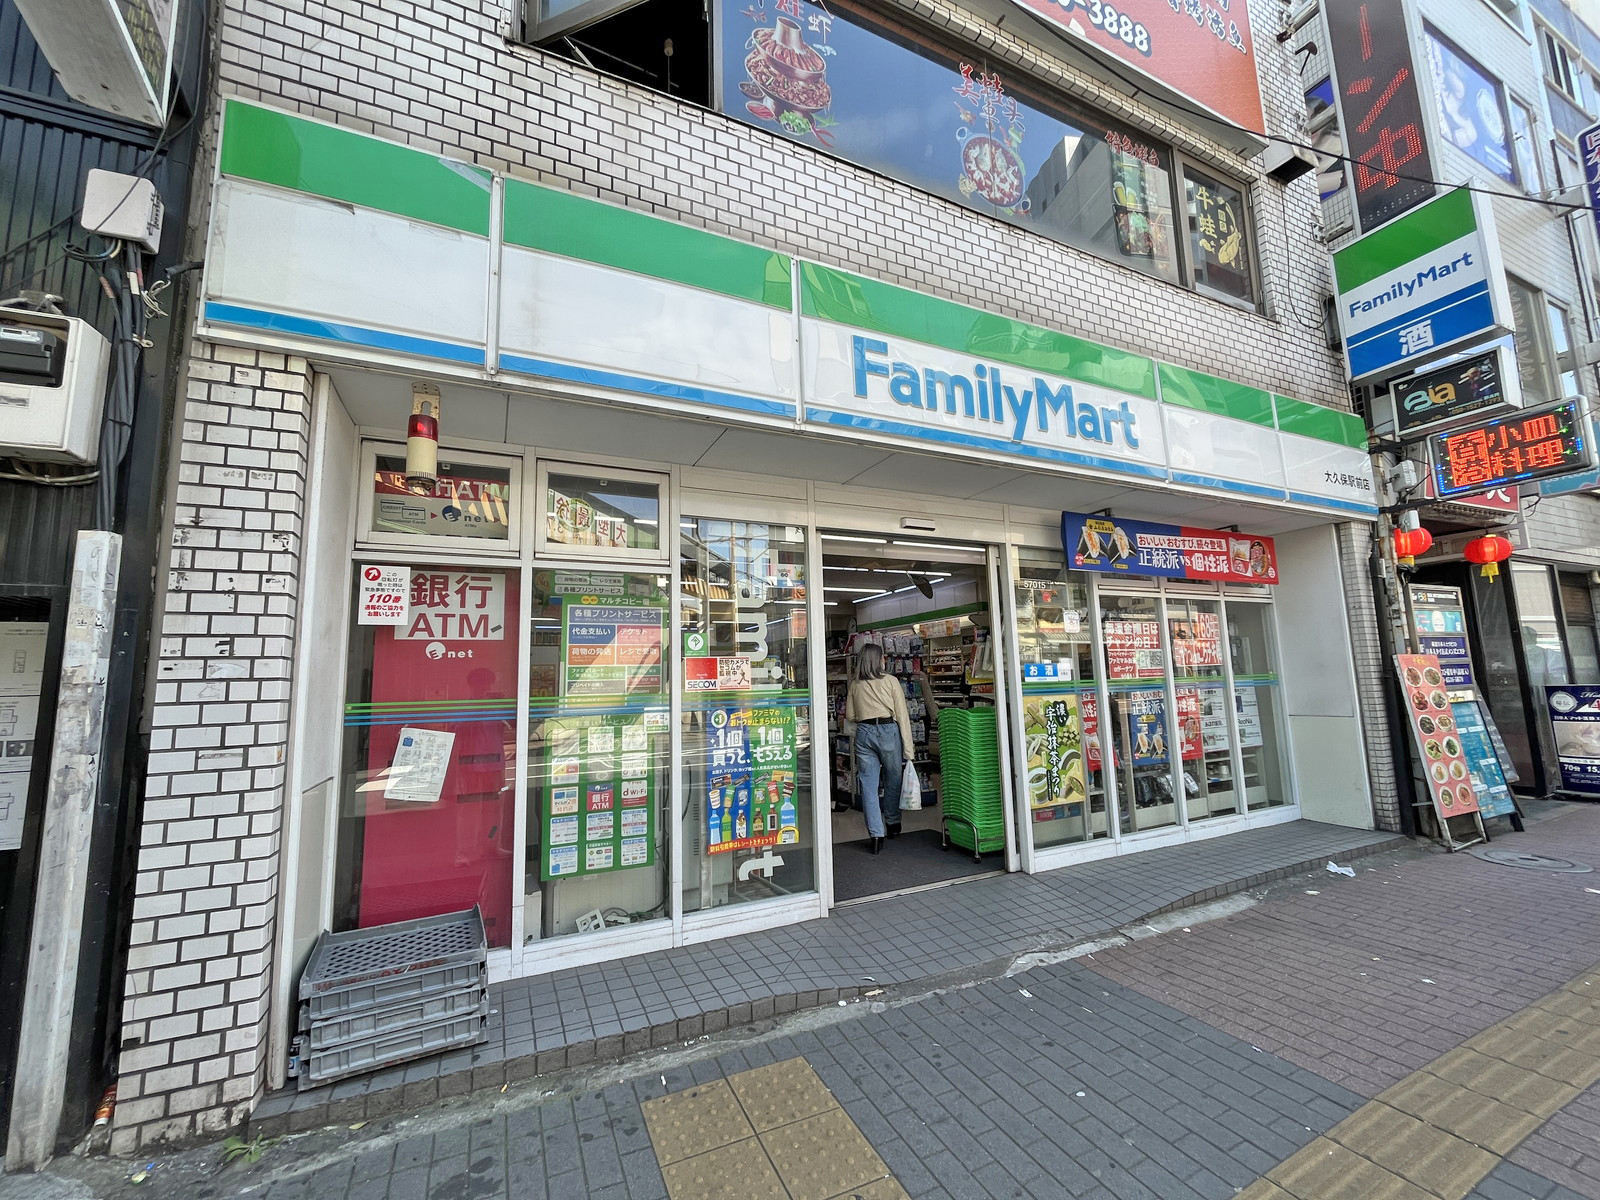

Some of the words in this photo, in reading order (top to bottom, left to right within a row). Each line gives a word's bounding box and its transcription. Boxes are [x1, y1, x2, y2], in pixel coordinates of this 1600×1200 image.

[1350, 251, 1474, 318] FamilyMart
[1398, 319, 1433, 356] 酒
[851, 337, 1139, 450] FamilyMart
[1491, 438, 1565, 477] 料理
[1324, 470, 1370, 491] 大久保駅前店
[369, 593, 402, 603] 110番
[411, 572, 493, 608] 銀行
[599, 597, 650, 605] マルチコピー機
[574, 609, 657, 618] 各種プリントサービス
[408, 612, 489, 638] ATM
[572, 627, 611, 636] 代金支払い
[1105, 622, 1158, 634] 毎週金曜日は
[571, 648, 612, 656] 荷物の発送
[1029, 665, 1054, 676] お酒
[753, 709, 781, 717] ファミマの
[1056, 703, 1067, 723] 濃い
[716, 728, 743, 748] 1個
[758, 726, 784, 746] 1個
[753, 745, 793, 763] もらえる
[1045, 706, 1061, 798] 宇治抹茶まつり
[592, 793, 610, 803] 銀行
[592, 802, 609, 810] ATM
